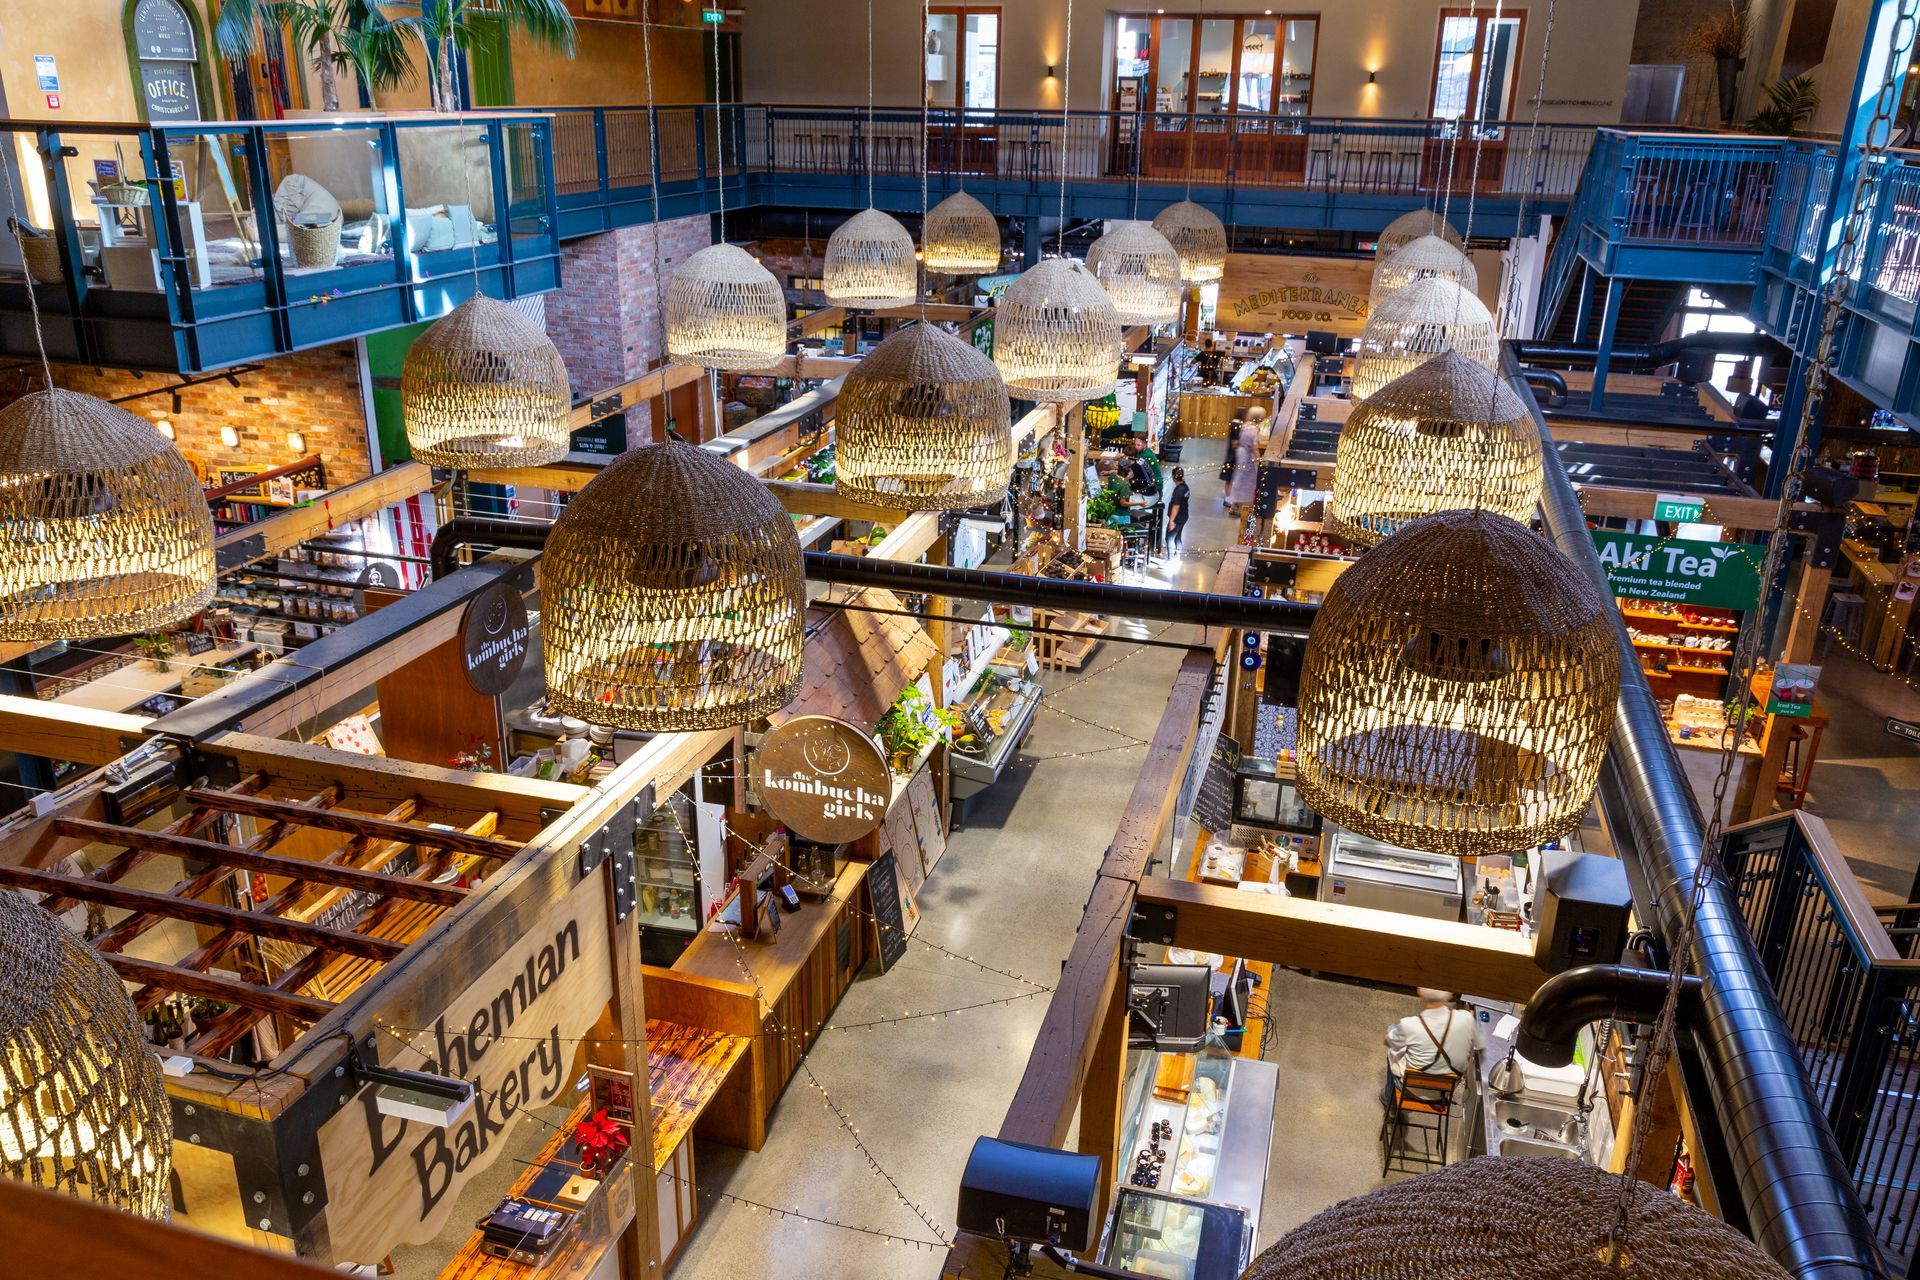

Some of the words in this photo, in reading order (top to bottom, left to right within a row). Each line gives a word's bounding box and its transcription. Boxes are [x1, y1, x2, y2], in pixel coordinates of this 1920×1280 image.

[1303, 271, 1320, 283] The
[1233, 286, 1368, 317] MEDITERRANEA
[1281, 309, 1313, 321] FOOD
[1314, 311, 1333, 322] CO.
[1665, 505, 1693, 520] EXIT
[1600, 540, 1653, 572] Aki
[1663, 546, 1718, 578] Tea
[1607, 573, 1647, 585] Premium
[1649, 577, 1663, 587] tea
[1664, 579, 1702, 591] blended
[1628, 587, 1650, 597] New
[1650, 588, 1686, 600] Zealand
[467, 627, 527, 670] kombucha
[480, 640, 491, 651] the
[498, 642, 524, 671] girls
[764, 768, 885, 807] kombucha
[792, 771, 813, 782] the
[822, 799, 874, 821] girls
[358, 919, 581, 1178] Bhemian
[410, 1023, 563, 1223] Bakery
